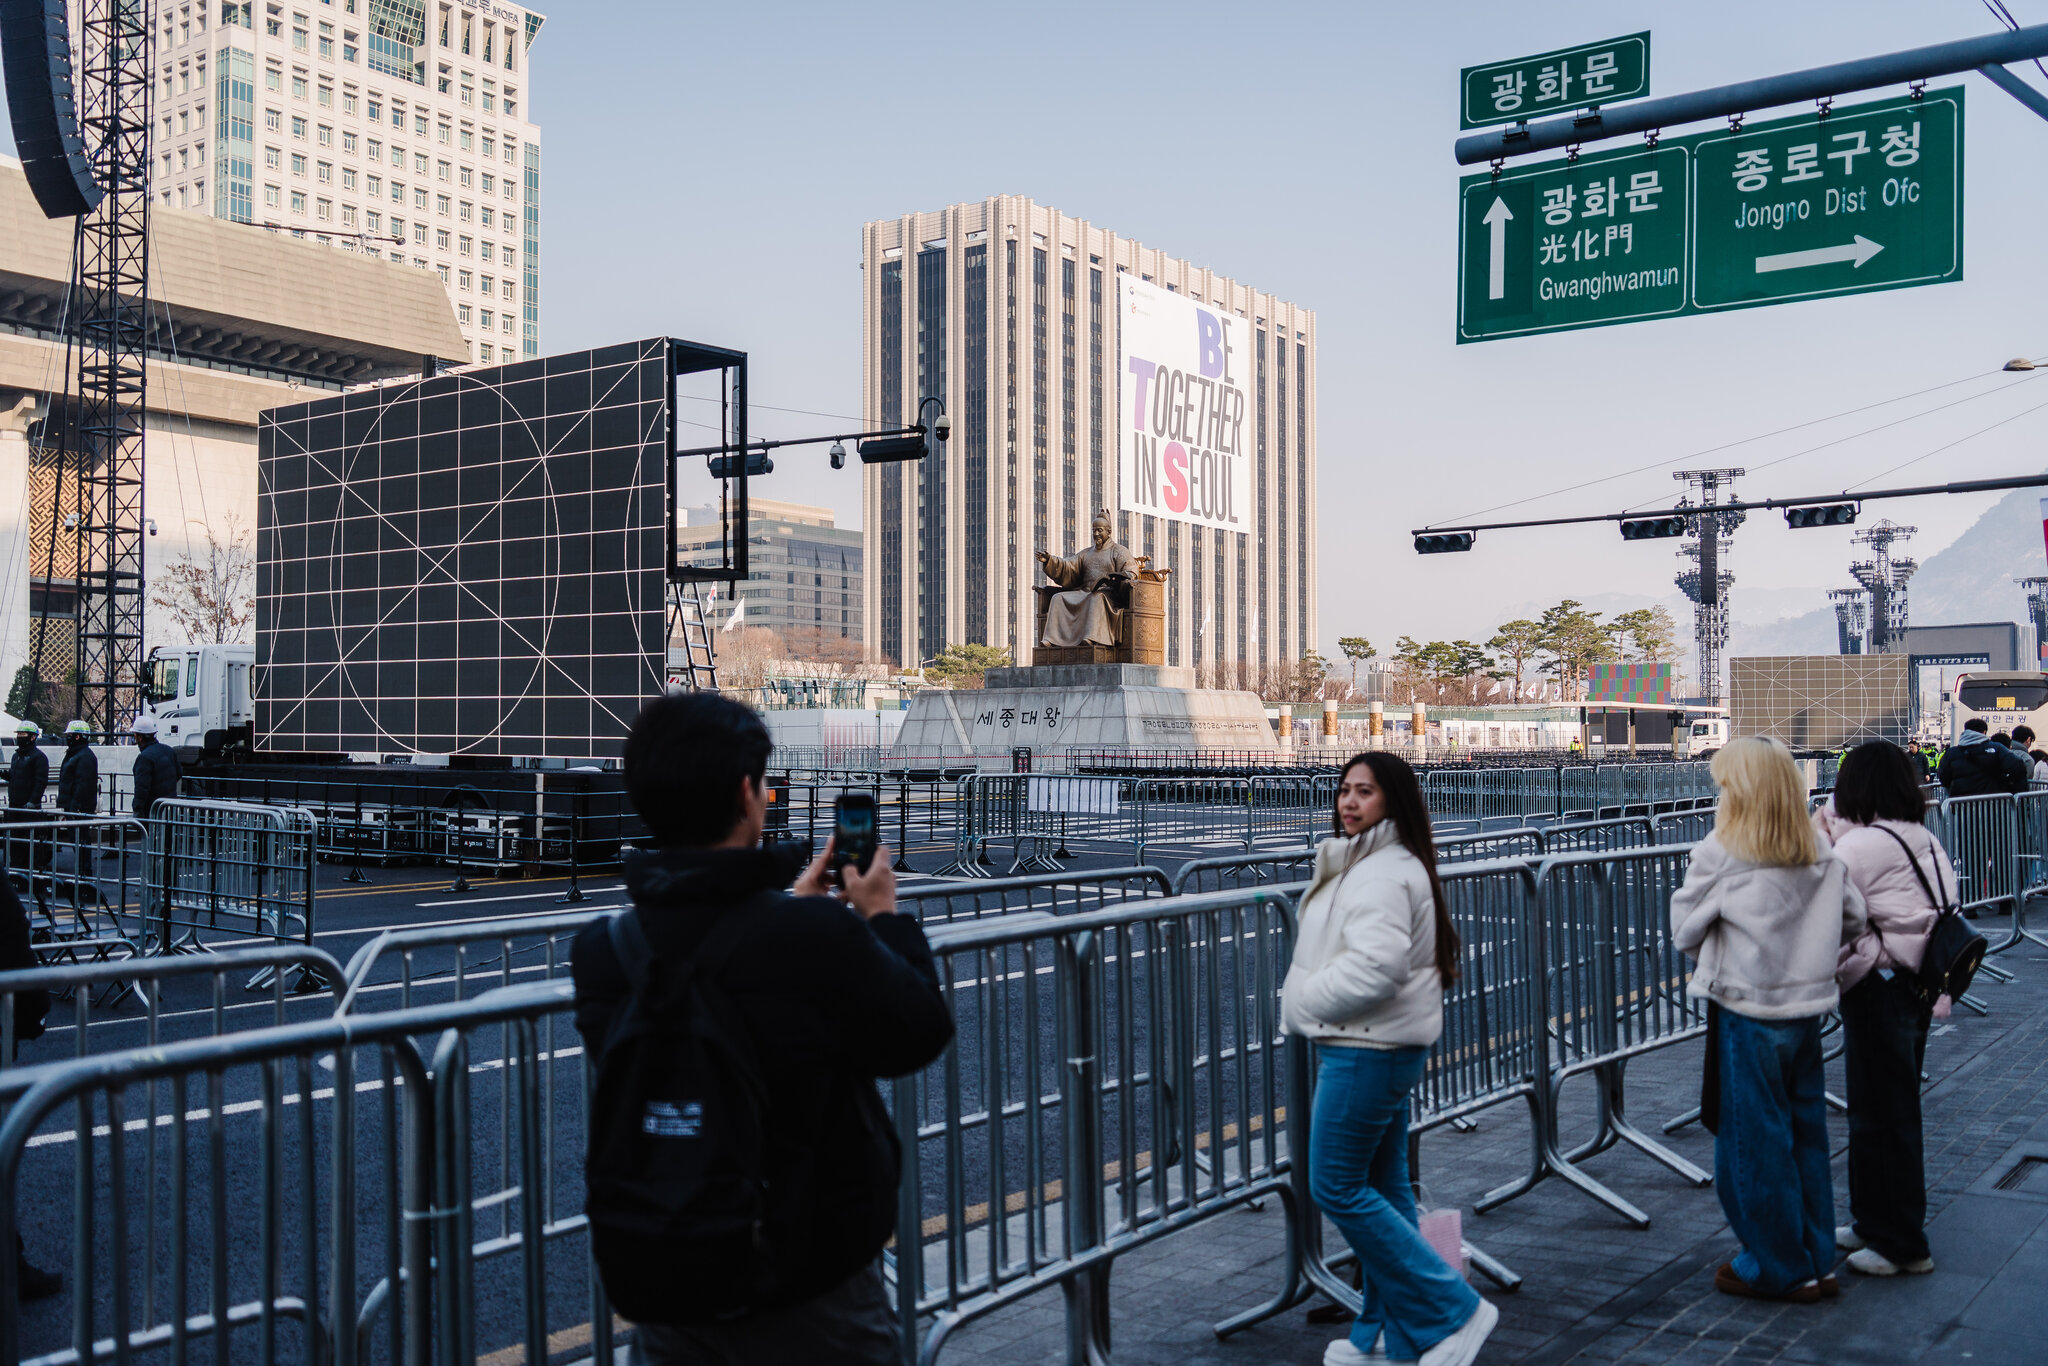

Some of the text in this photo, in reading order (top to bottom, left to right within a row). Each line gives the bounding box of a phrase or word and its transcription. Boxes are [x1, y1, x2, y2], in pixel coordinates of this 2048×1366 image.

[493, 6, 519, 24] MOFA
[1490, 51, 1619, 112] 광화문
[1731, 120, 1921, 193] 종로구청
[1540, 170, 1663, 227] 광화문
[1735, 177, 1921, 230] Jongno Dist Ofc
[1539, 222, 1634, 266] 光化門
[1539, 266, 1680, 301] Gwanghwamun
[1196, 307, 1235, 385] BE
[1129, 355, 1244, 457] TOGETHER
[1134, 431, 1239, 524] IN SEOUL
